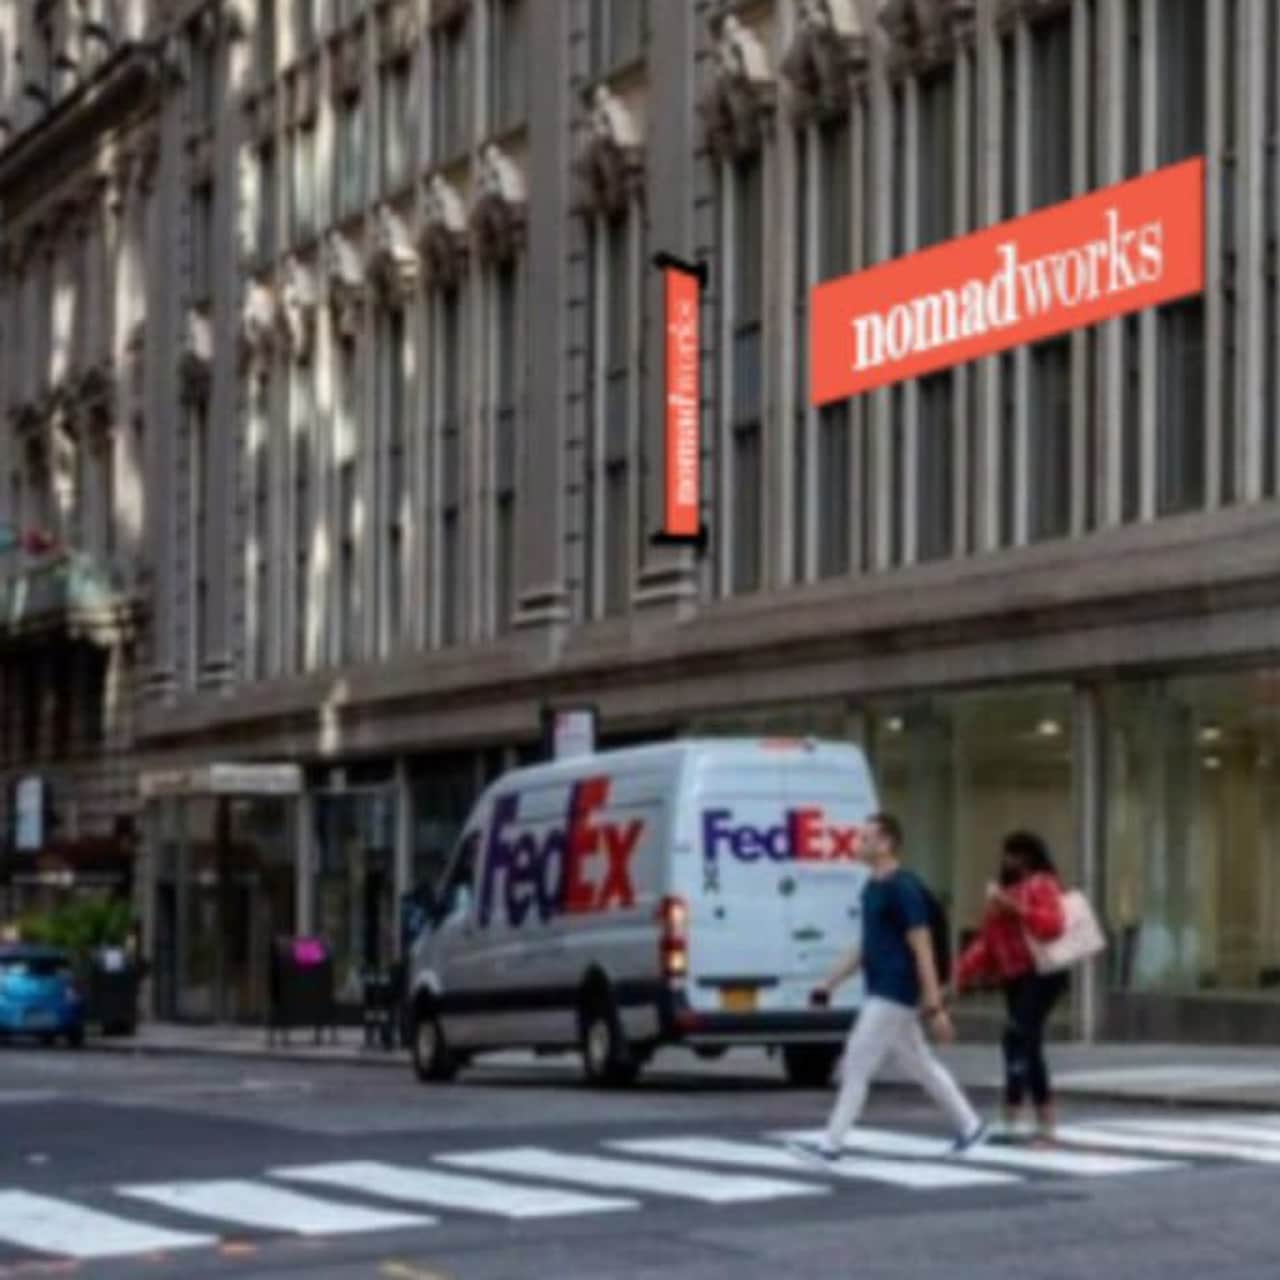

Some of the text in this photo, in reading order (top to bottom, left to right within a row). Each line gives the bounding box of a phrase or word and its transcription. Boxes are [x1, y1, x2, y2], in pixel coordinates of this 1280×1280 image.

[851, 207, 1164, 374] nomadworks
[478, 773, 643, 929] FedEx
[701, 806, 862, 862] FedEx
